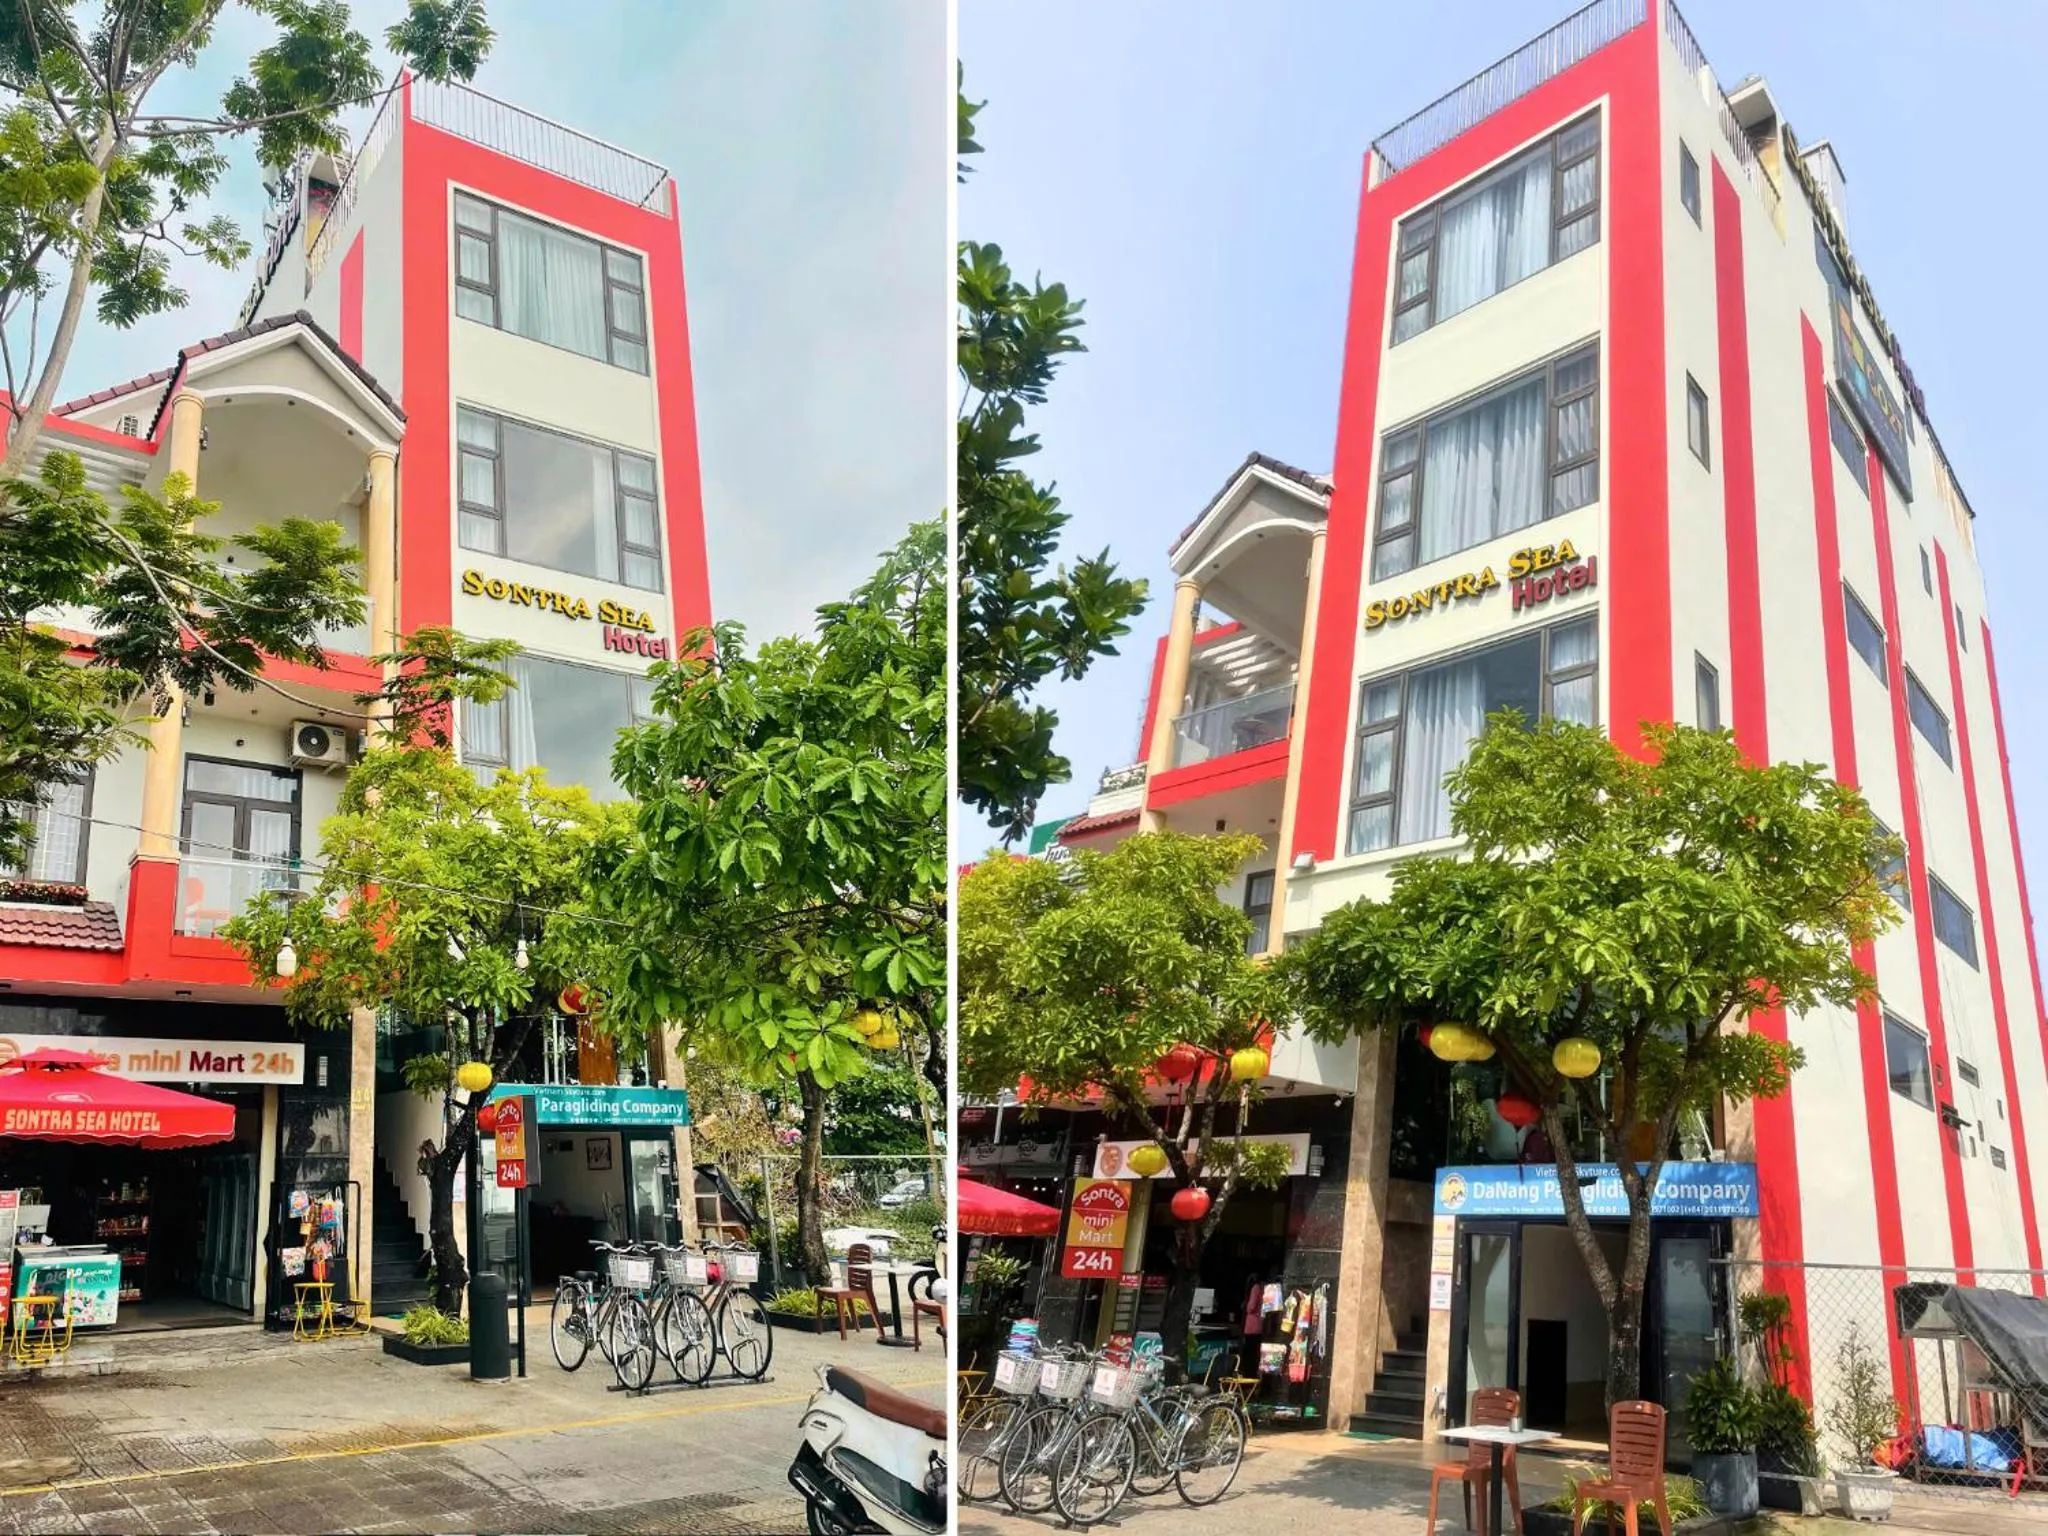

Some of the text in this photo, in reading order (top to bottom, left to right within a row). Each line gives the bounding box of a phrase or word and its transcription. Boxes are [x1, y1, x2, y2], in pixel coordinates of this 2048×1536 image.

[1364, 538, 1580, 629] SONTRA SEA
[1511, 555, 1598, 611] Hotel
[462, 567, 656, 633] SONTRA SEA
[603, 624, 670, 660] Hotel
[128, 1049, 181, 1071] mini
[189, 1050, 245, 1073] Mart
[251, 1052, 295, 1074] 24h
[541, 1098, 684, 1116] Paragliding Company
[4, 1108, 160, 1132] SONTRA SEA HOTEL
[501, 1163, 521, 1181] 24h
[1080, 1187, 1125, 1209] Sontra
[1472, 1181, 1539, 1203] DaNang
[1654, 1179, 1751, 1204] Company
[1083, 1213, 1115, 1227] mini
[1079, 1230, 1113, 1243] Mart
[1072, 1251, 1113, 1271] 24h
